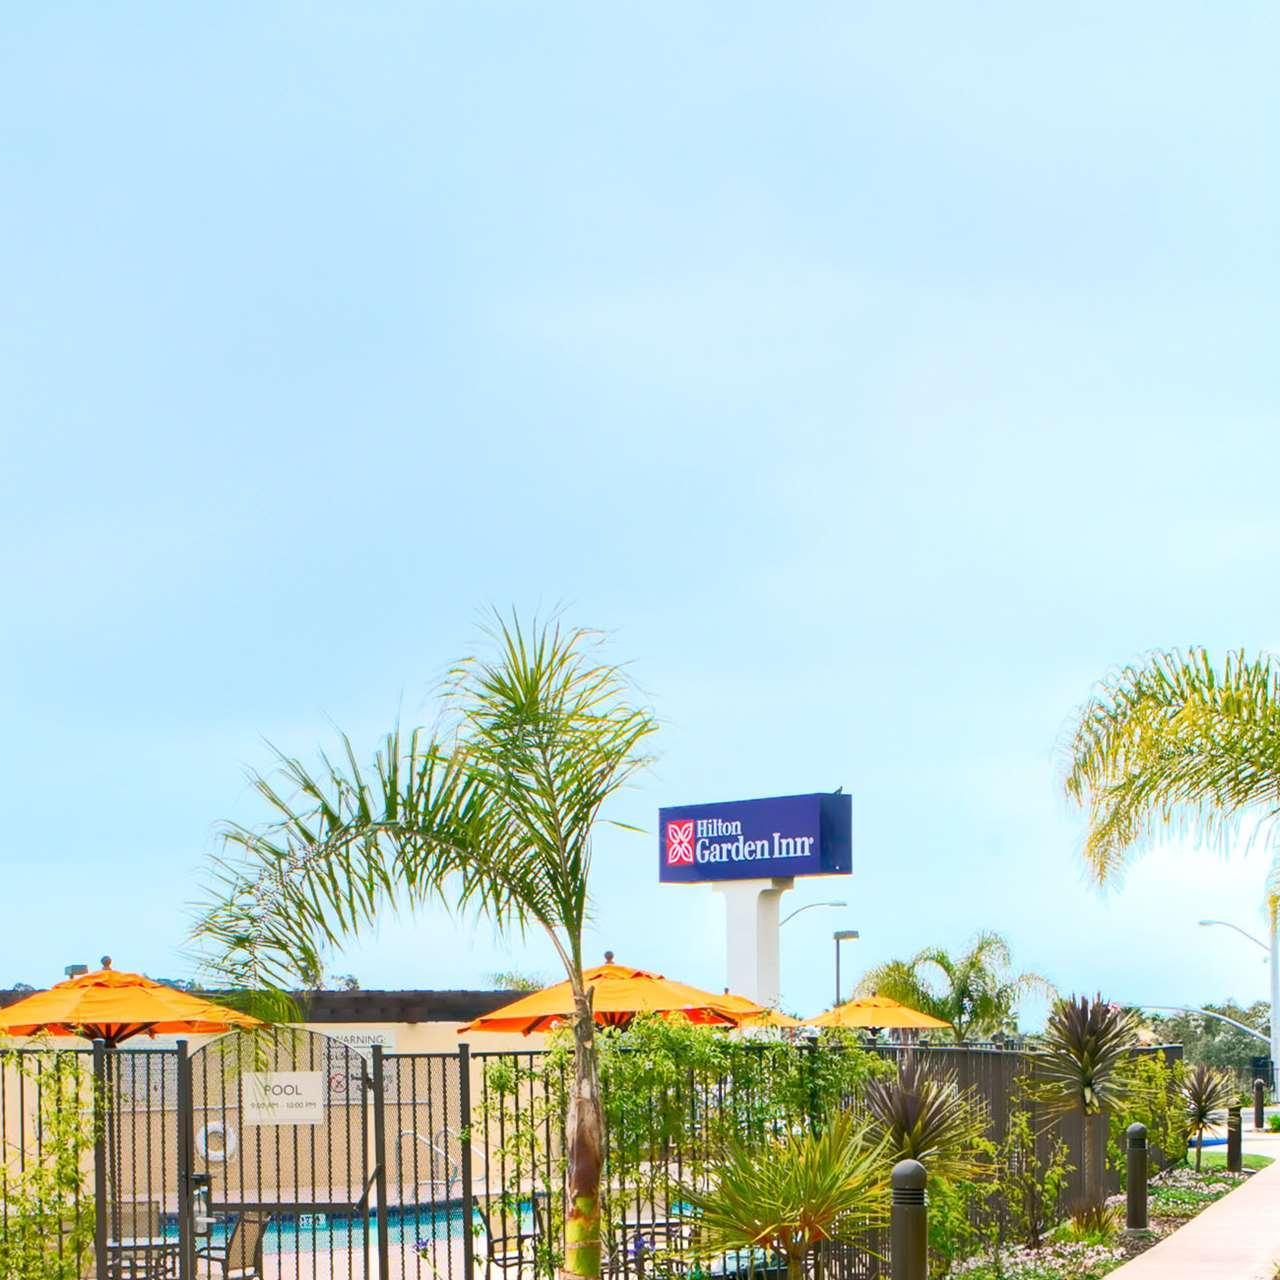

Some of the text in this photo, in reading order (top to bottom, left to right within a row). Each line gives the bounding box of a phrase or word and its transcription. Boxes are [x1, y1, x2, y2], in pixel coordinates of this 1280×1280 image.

[696, 819, 742, 837] Hilton
[695, 832, 812, 864] Garden Inn
[263, 1084, 303, 1096] POOL
